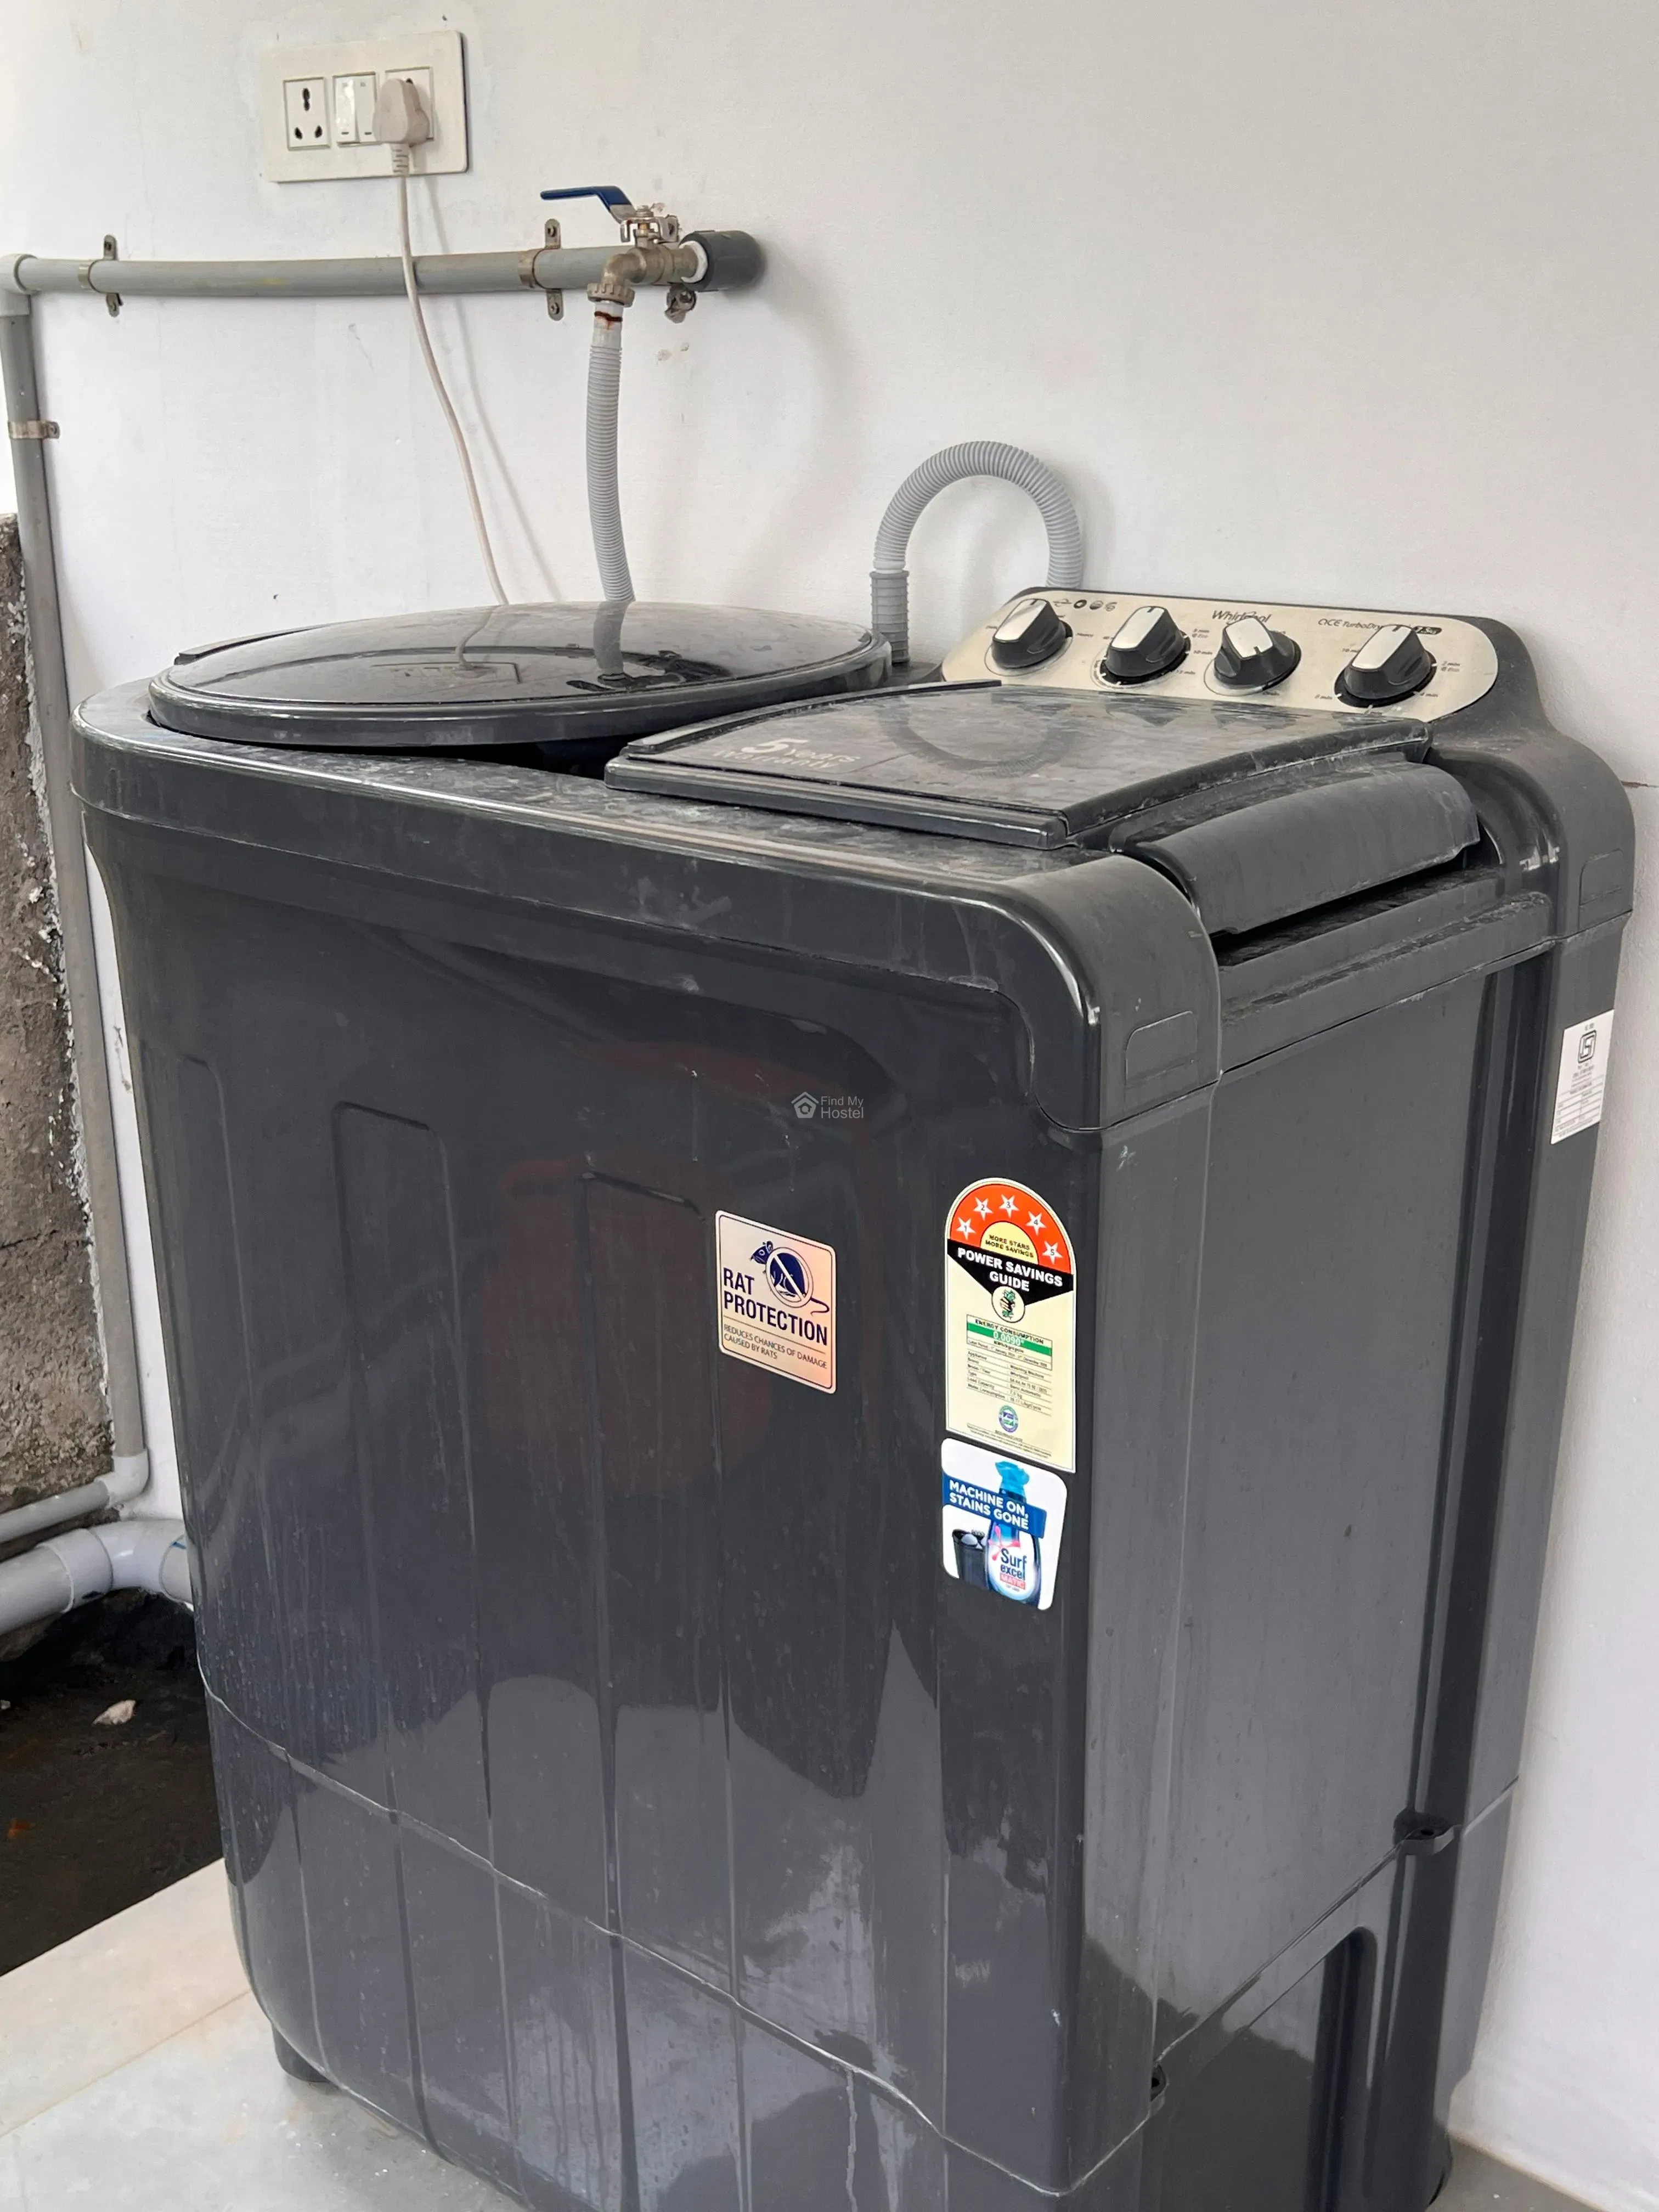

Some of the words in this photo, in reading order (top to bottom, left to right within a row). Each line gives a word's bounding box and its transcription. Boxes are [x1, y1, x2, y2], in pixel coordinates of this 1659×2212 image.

[741, 737, 810, 754] 5
[985, 1240, 1005, 1250] MORE
[1005, 1245, 1034, 1258] SAVINGS
[989, 1234, 1008, 1244] MORE
[1009, 1239, 1030, 1250] STARS
[723, 1267, 755, 1295] RAT
[957, 1247, 1003, 1270] POWER
[1005, 1261, 1063, 1288] SAVINGS
[989, 1270, 1030, 1292] GUIDE
[723, 1291, 828, 1346] PROTECTION
[975, 1318, 999, 1329] ENERGY
[1000, 1326, 1045, 1345] CONSUMPTION
[724, 1324, 753, 1341] REDUCES
[754, 1334, 786, 1352] CHANCES
[786, 1345, 796, 1356] OF
[797, 1350, 828, 1369] DAMAGE
[724, 1333, 751, 1350] CAUSED
[751, 1344, 760, 1353] BY
[760, 1346, 778, 1360] RATS
[949, 1479, 1004, 1509] MACHINE
[1006, 1498, 1029, 1519] ON,
[949, 1493, 991, 1518] STAINS
[994, 1508, 1029, 1531] GONE
[1000, 1548, 1027, 1569] Surf
[1000, 1564, 1025, 1581] excel
